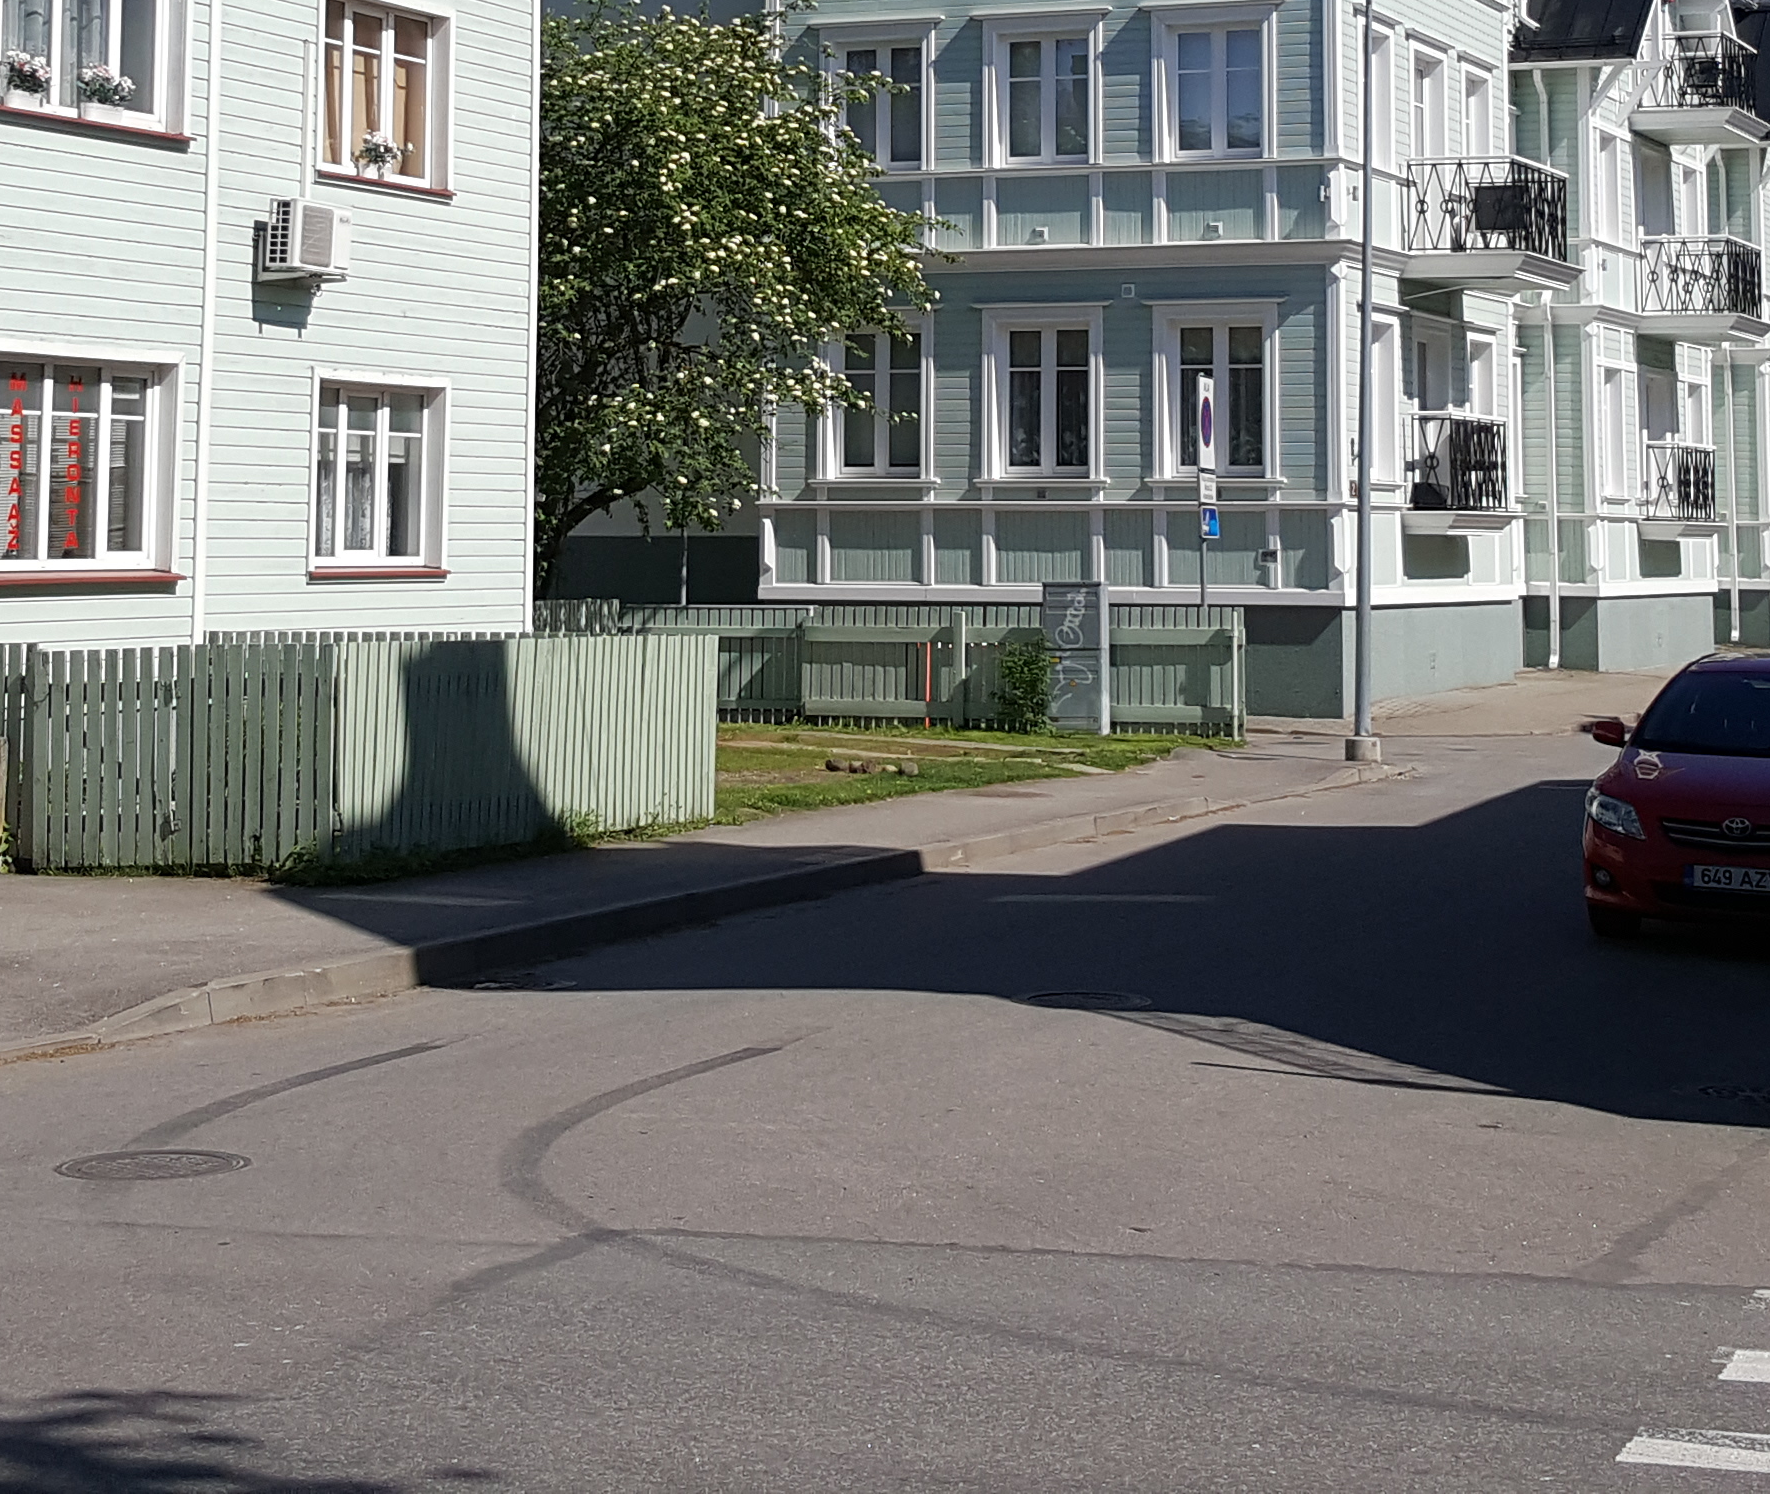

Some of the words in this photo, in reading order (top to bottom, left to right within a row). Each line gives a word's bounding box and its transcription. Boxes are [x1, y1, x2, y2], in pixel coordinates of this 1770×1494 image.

[7, 372, 28, 550] MASSAAŽ
[64, 375, 84, 548] HIERONTA
[1700, 868, 1733, 887] 649
